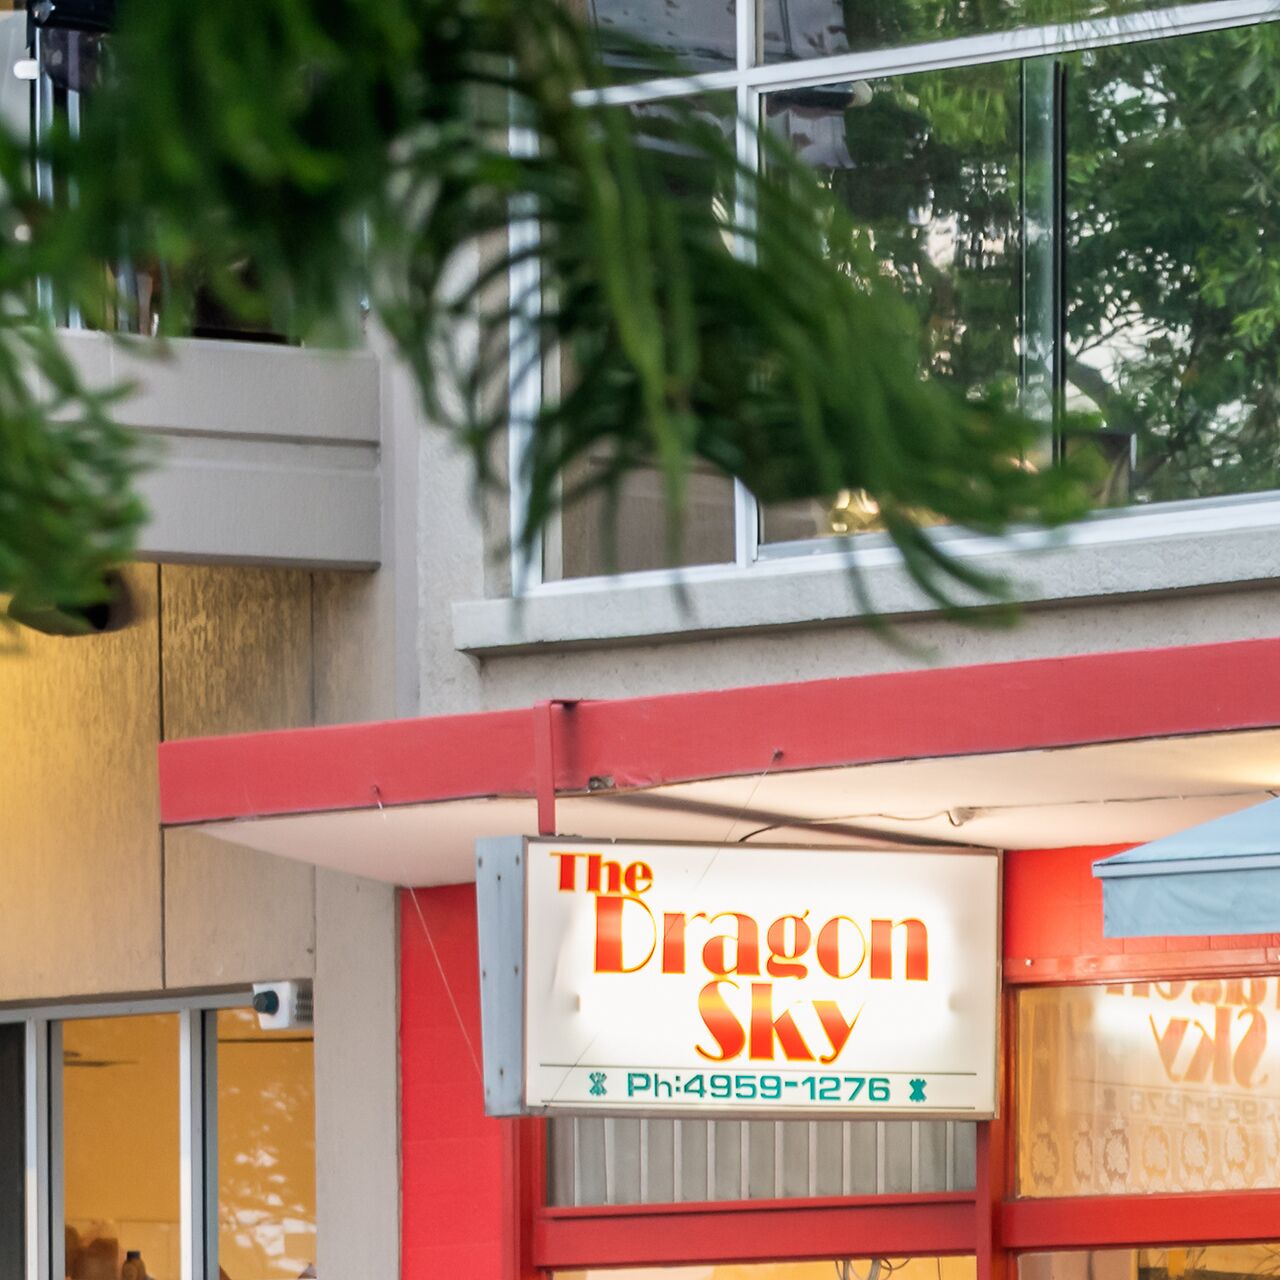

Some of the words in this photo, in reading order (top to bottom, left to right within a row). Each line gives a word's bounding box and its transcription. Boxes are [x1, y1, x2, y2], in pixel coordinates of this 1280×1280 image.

[549, 852, 653, 895] The
[593, 895, 930, 981] Dragon
[694, 979, 866, 1065] Sky
[627, 1072, 892, 1103] Ph:4959-1276
